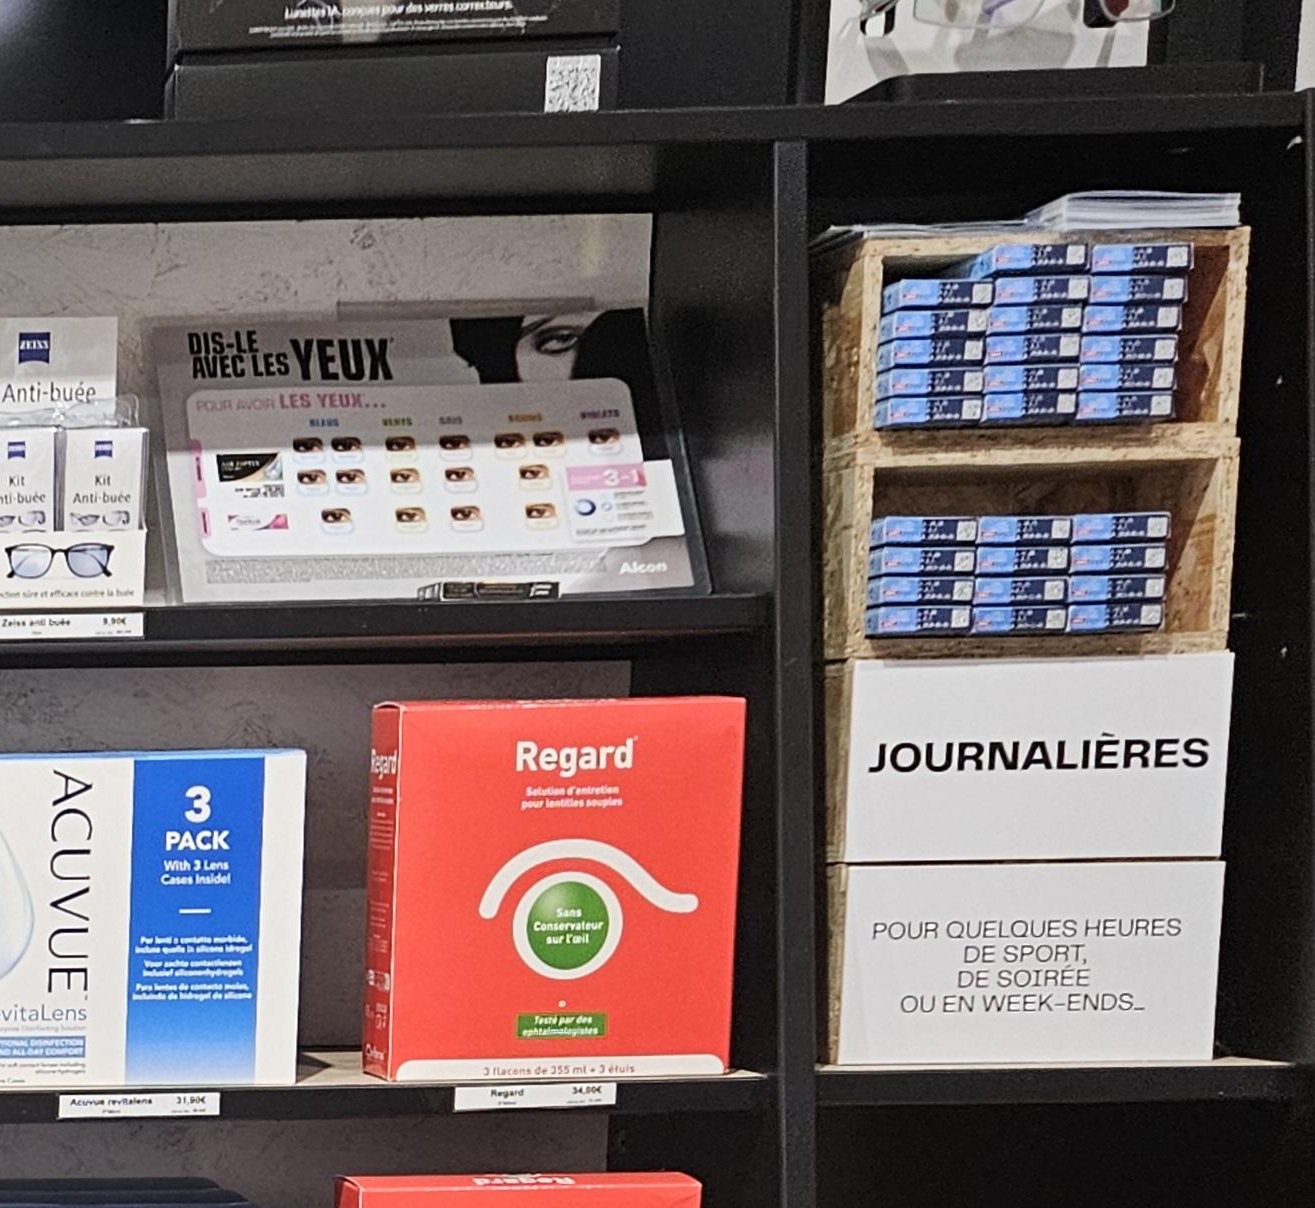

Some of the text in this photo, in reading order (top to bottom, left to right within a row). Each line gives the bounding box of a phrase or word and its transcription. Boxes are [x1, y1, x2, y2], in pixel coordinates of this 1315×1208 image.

[20, 340, 49, 351] ZEISS
[188, 330, 259, 355] DIS-LE
[192, 352, 290, 379] AVEC LES
[290, 337, 394, 382] YEUX
[2, 381, 96, 403] Anti-buée
[195, 400, 230, 413] POUR
[233, 398, 275, 412] AVOIR
[279, 394, 312, 411] LES
[9, 475, 25, 487] Kit
[619, 560, 668, 575] Alcon
[516, 738, 633, 777] Regard
[868, 733, 1210, 774] JOURNALIÈRES
[526, 785, 619, 797] Solution d'entretien
[185, 786, 212, 823] 3
[522, 797, 623, 810] pour lentilles souples
[165, 831, 230, 851] PACK
[164, 860, 229, 871] With 3 Lens
[48, 769, 93, 993] ACUVUE
[161, 873, 231, 885] Cases Inside!
[556, 907, 582, 918] Sans
[534, 920, 604, 932] Conservateur
[872, 918, 1182, 940] POUR QUELQUES HEURES
[546, 934, 565, 945] sur
[964, 944, 1087, 966] DE SPORT,
[957, 965, 1090, 989] DE SOIRÉE
[900, 995, 936, 1014] OU
[943, 995, 974, 1013] EN
